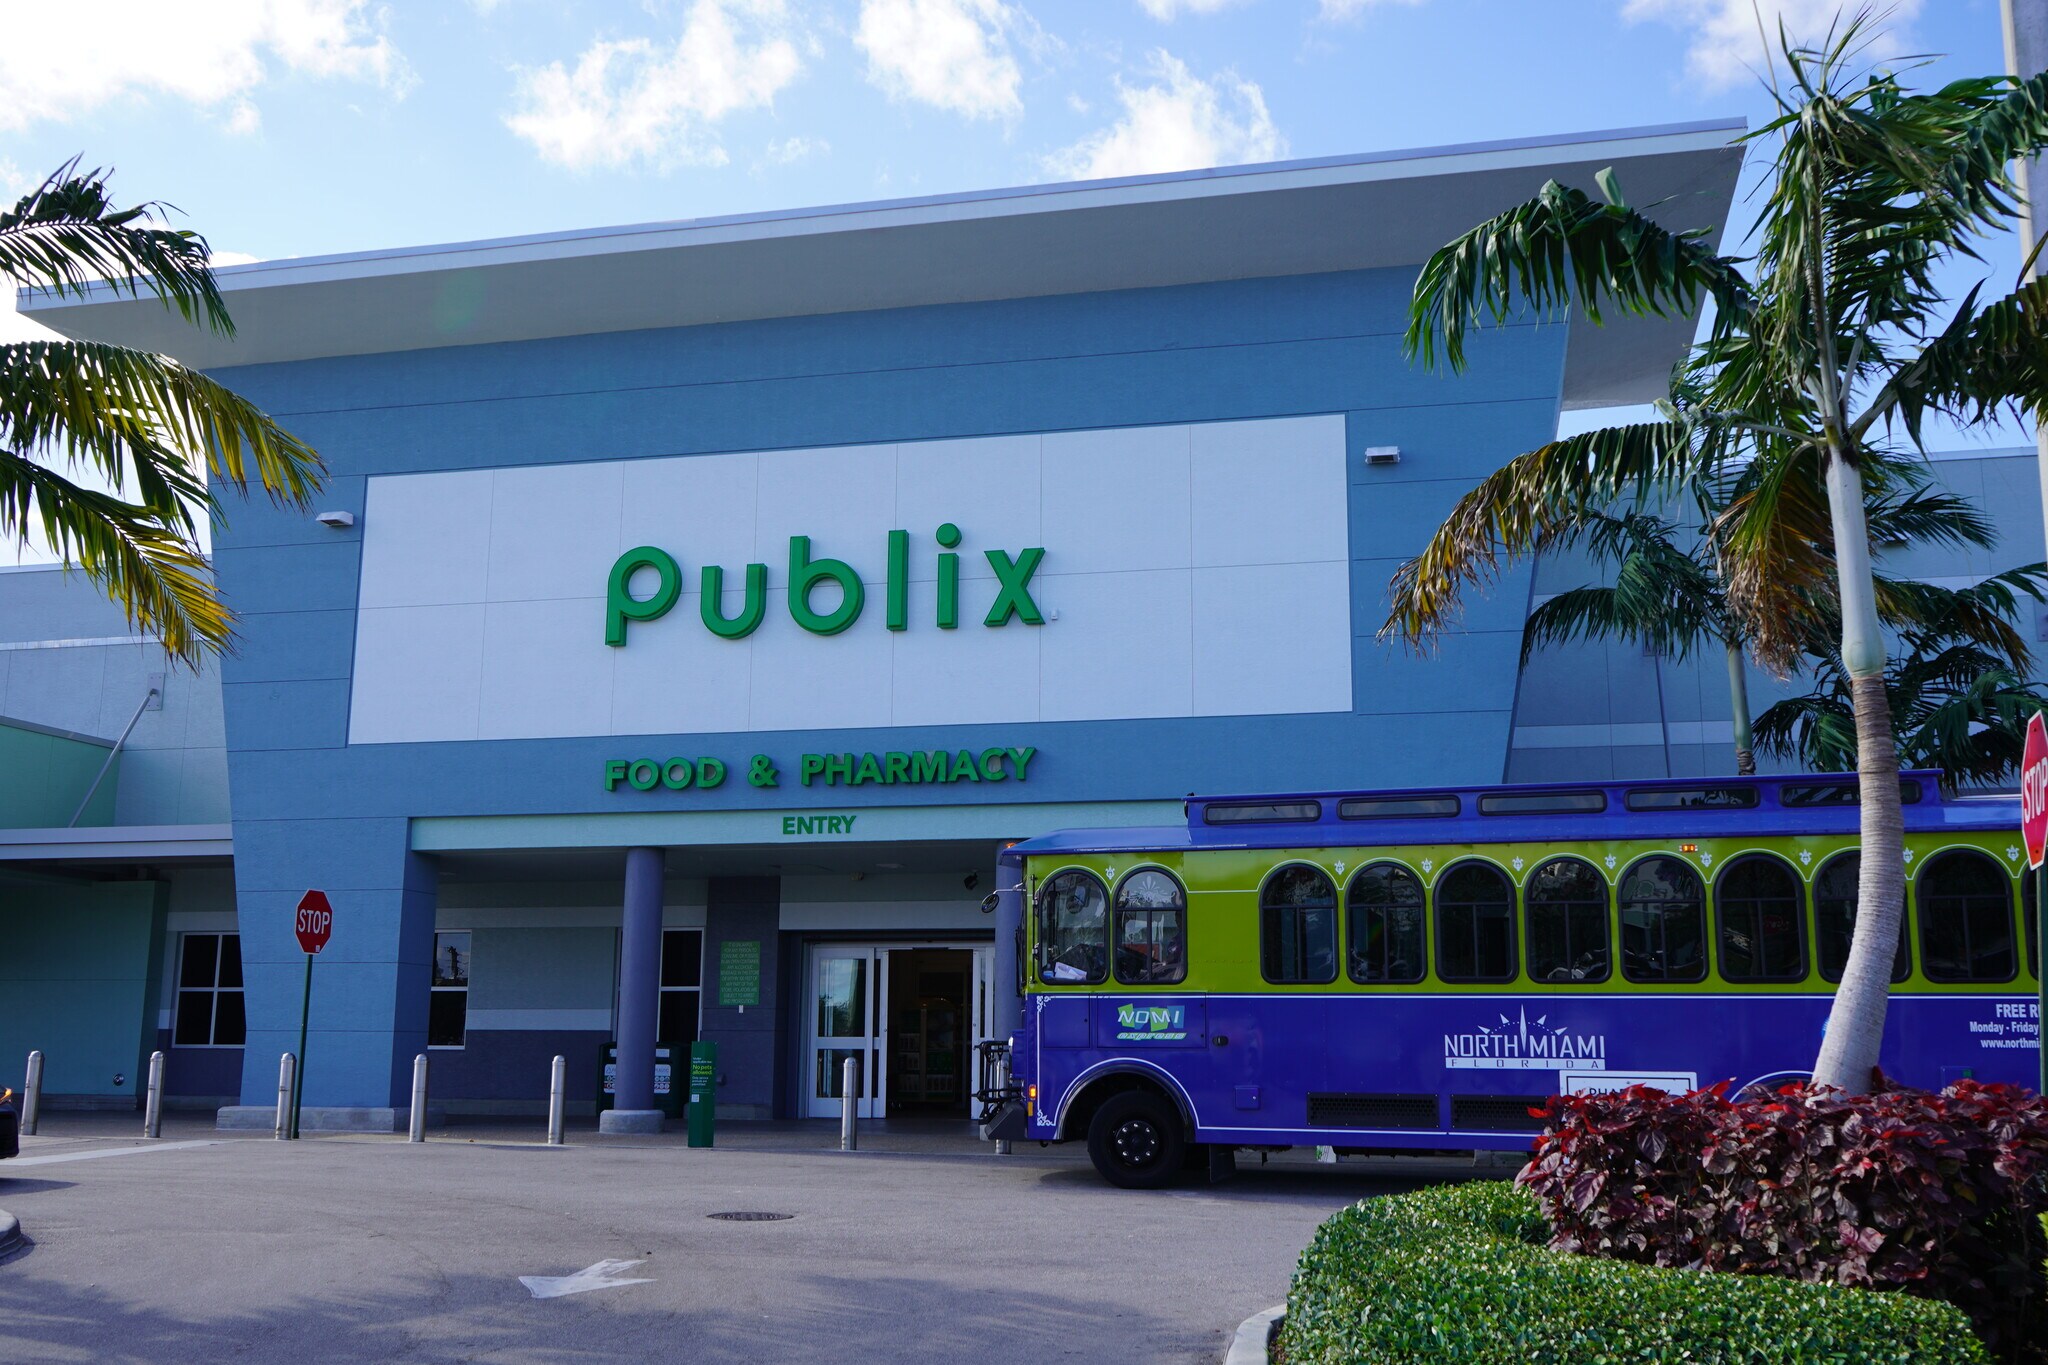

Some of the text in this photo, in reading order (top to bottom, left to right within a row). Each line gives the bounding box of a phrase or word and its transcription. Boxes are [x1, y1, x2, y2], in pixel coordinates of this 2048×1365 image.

[605, 523, 1046, 647] Publix
[604, 747, 1037, 792] FOOD & PHARMACY
[2023, 757, 2048, 824] STOP
[783, 816, 857, 835] ENTRY
[298, 909, 331, 934] STOP
[1117, 1010, 1180, 1024] NOMI
[1995, 1004, 2027, 1018] FREE
[1117, 1032, 1187, 1041] express
[1969, 1021, 2004, 1035] Monday
[2011, 1021, 2039, 1035] Friday
[1444, 1034, 1605, 1058] NORTH MIAMI
[1451, 1059, 1599, 1069] FLORIDA
